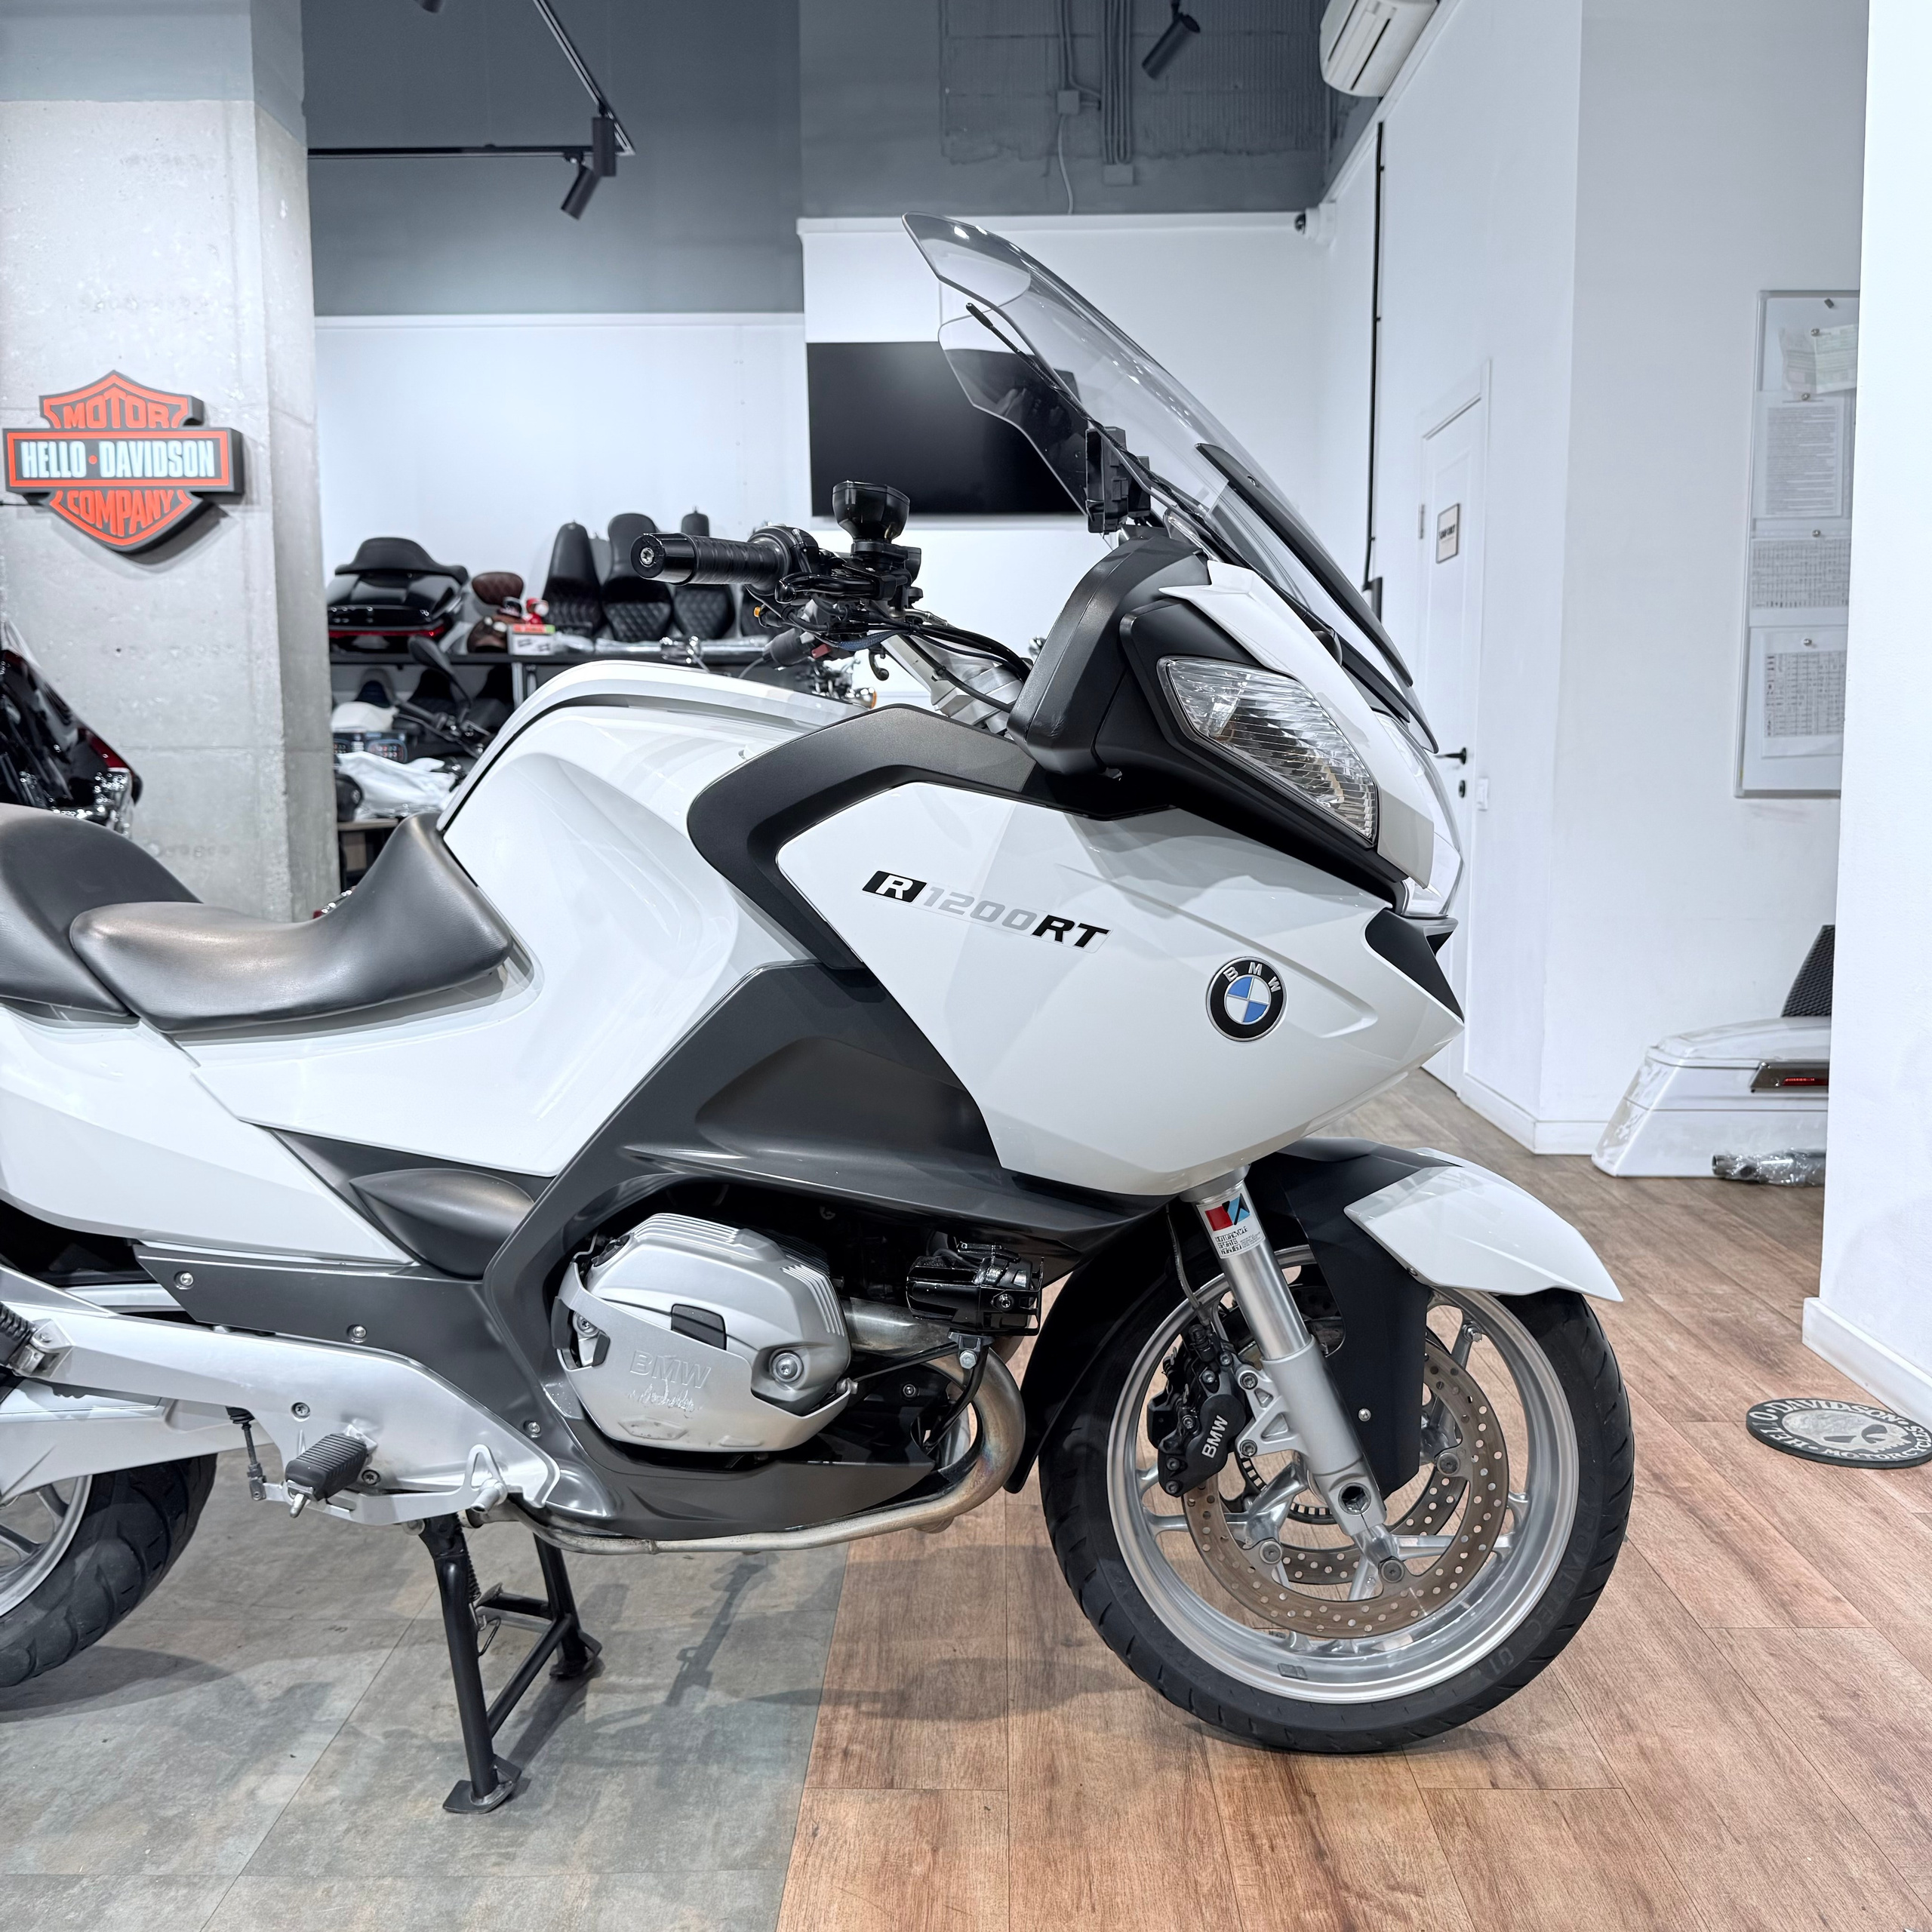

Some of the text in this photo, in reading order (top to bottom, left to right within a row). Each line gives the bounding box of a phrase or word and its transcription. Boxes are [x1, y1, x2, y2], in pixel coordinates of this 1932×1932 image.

[63, 386, 170, 429] MOTOR
[20, 440, 215, 478] HELLO DAVIDSON
[66, 489, 174, 537] COMPANY
[1223, 961, 1281, 993] BMW
[629, 1350, 712, 1389] BMW
[1764, 1399, 1906, 1423] DAVIDSON
[1201, 1415, 1229, 1458] BMW
